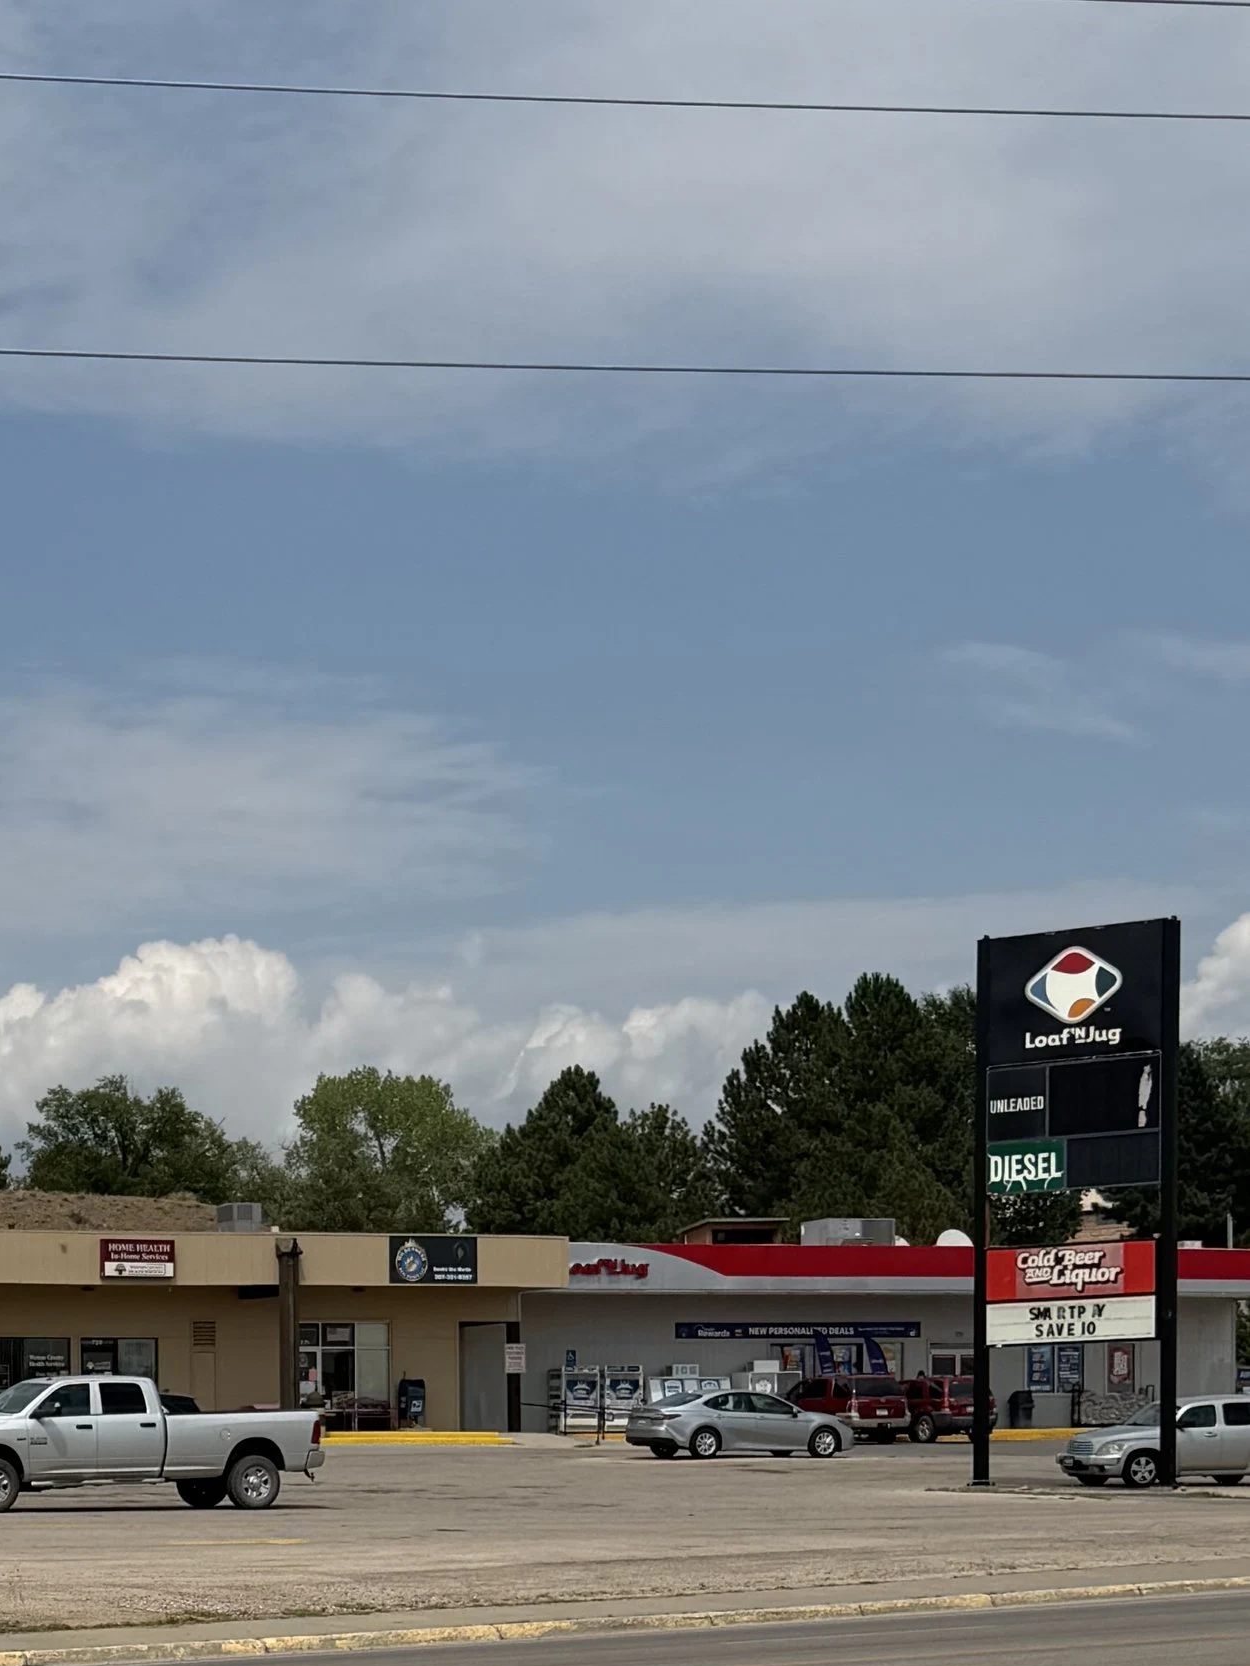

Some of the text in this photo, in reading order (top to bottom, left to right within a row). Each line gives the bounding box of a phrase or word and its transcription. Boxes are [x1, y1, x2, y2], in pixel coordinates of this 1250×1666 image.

[1025, 1028, 1070, 1049] Loaf
[989, 1095, 1044, 1114] UNLEADED
[989, 1152, 1063, 1184] DIESEL
[108, 1243, 171, 1253] HOME HEALTH
[110, 1252, 169, 1261] In-Home Services
[1016, 1249, 1105, 1269] Cold Beer
[1025, 1264, 1122, 1292] AND Liquor
[697, 1329, 730, 1337] Rewards
[748, 1327, 767, 1335] NEW
[829, 1326, 854, 1335] DEALS
[1035, 1322, 1075, 1337] SAVE
